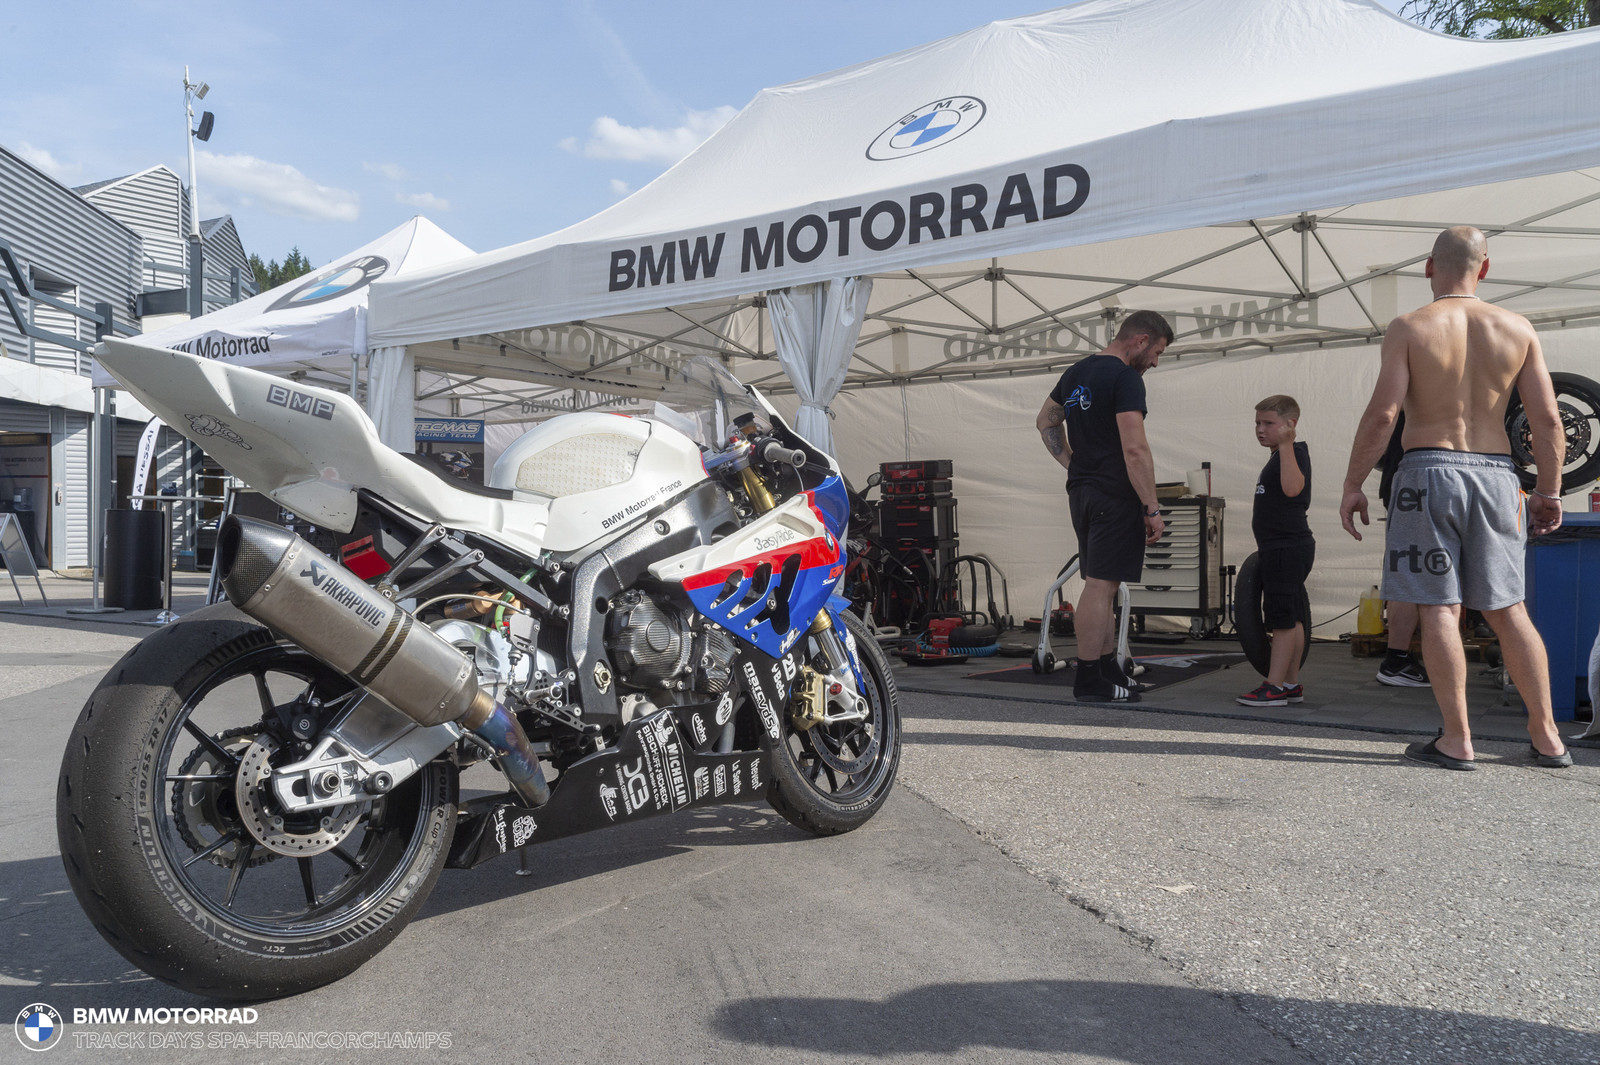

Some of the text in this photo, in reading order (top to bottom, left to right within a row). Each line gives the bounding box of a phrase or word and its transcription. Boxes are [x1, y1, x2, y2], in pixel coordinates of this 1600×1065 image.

[899, 100, 978, 126] BMW
[608, 163, 1091, 292] BMW MOTORRAD
[196, 332, 274, 358] Motorrad
[269, 386, 333, 415] BMP
[414, 421, 481, 434] TECMAS
[602, 510, 626, 529] BMW
[660, 479, 683, 494] France
[773, 669, 786, 701] Beta
[694, 714, 708, 744] alpha
[139, 752, 152, 808] 190/55
[148, 726, 161, 751] ZR
[667, 742, 687, 805] MICHELIN
[702, 766, 710, 795] ALPHA
[732, 760, 741, 772] La
[751, 758, 763, 790] thevent
[436, 765, 447, 819] POWER
[656, 773, 669, 806] SCHECK
[140, 825, 192, 915] MICHELIN
